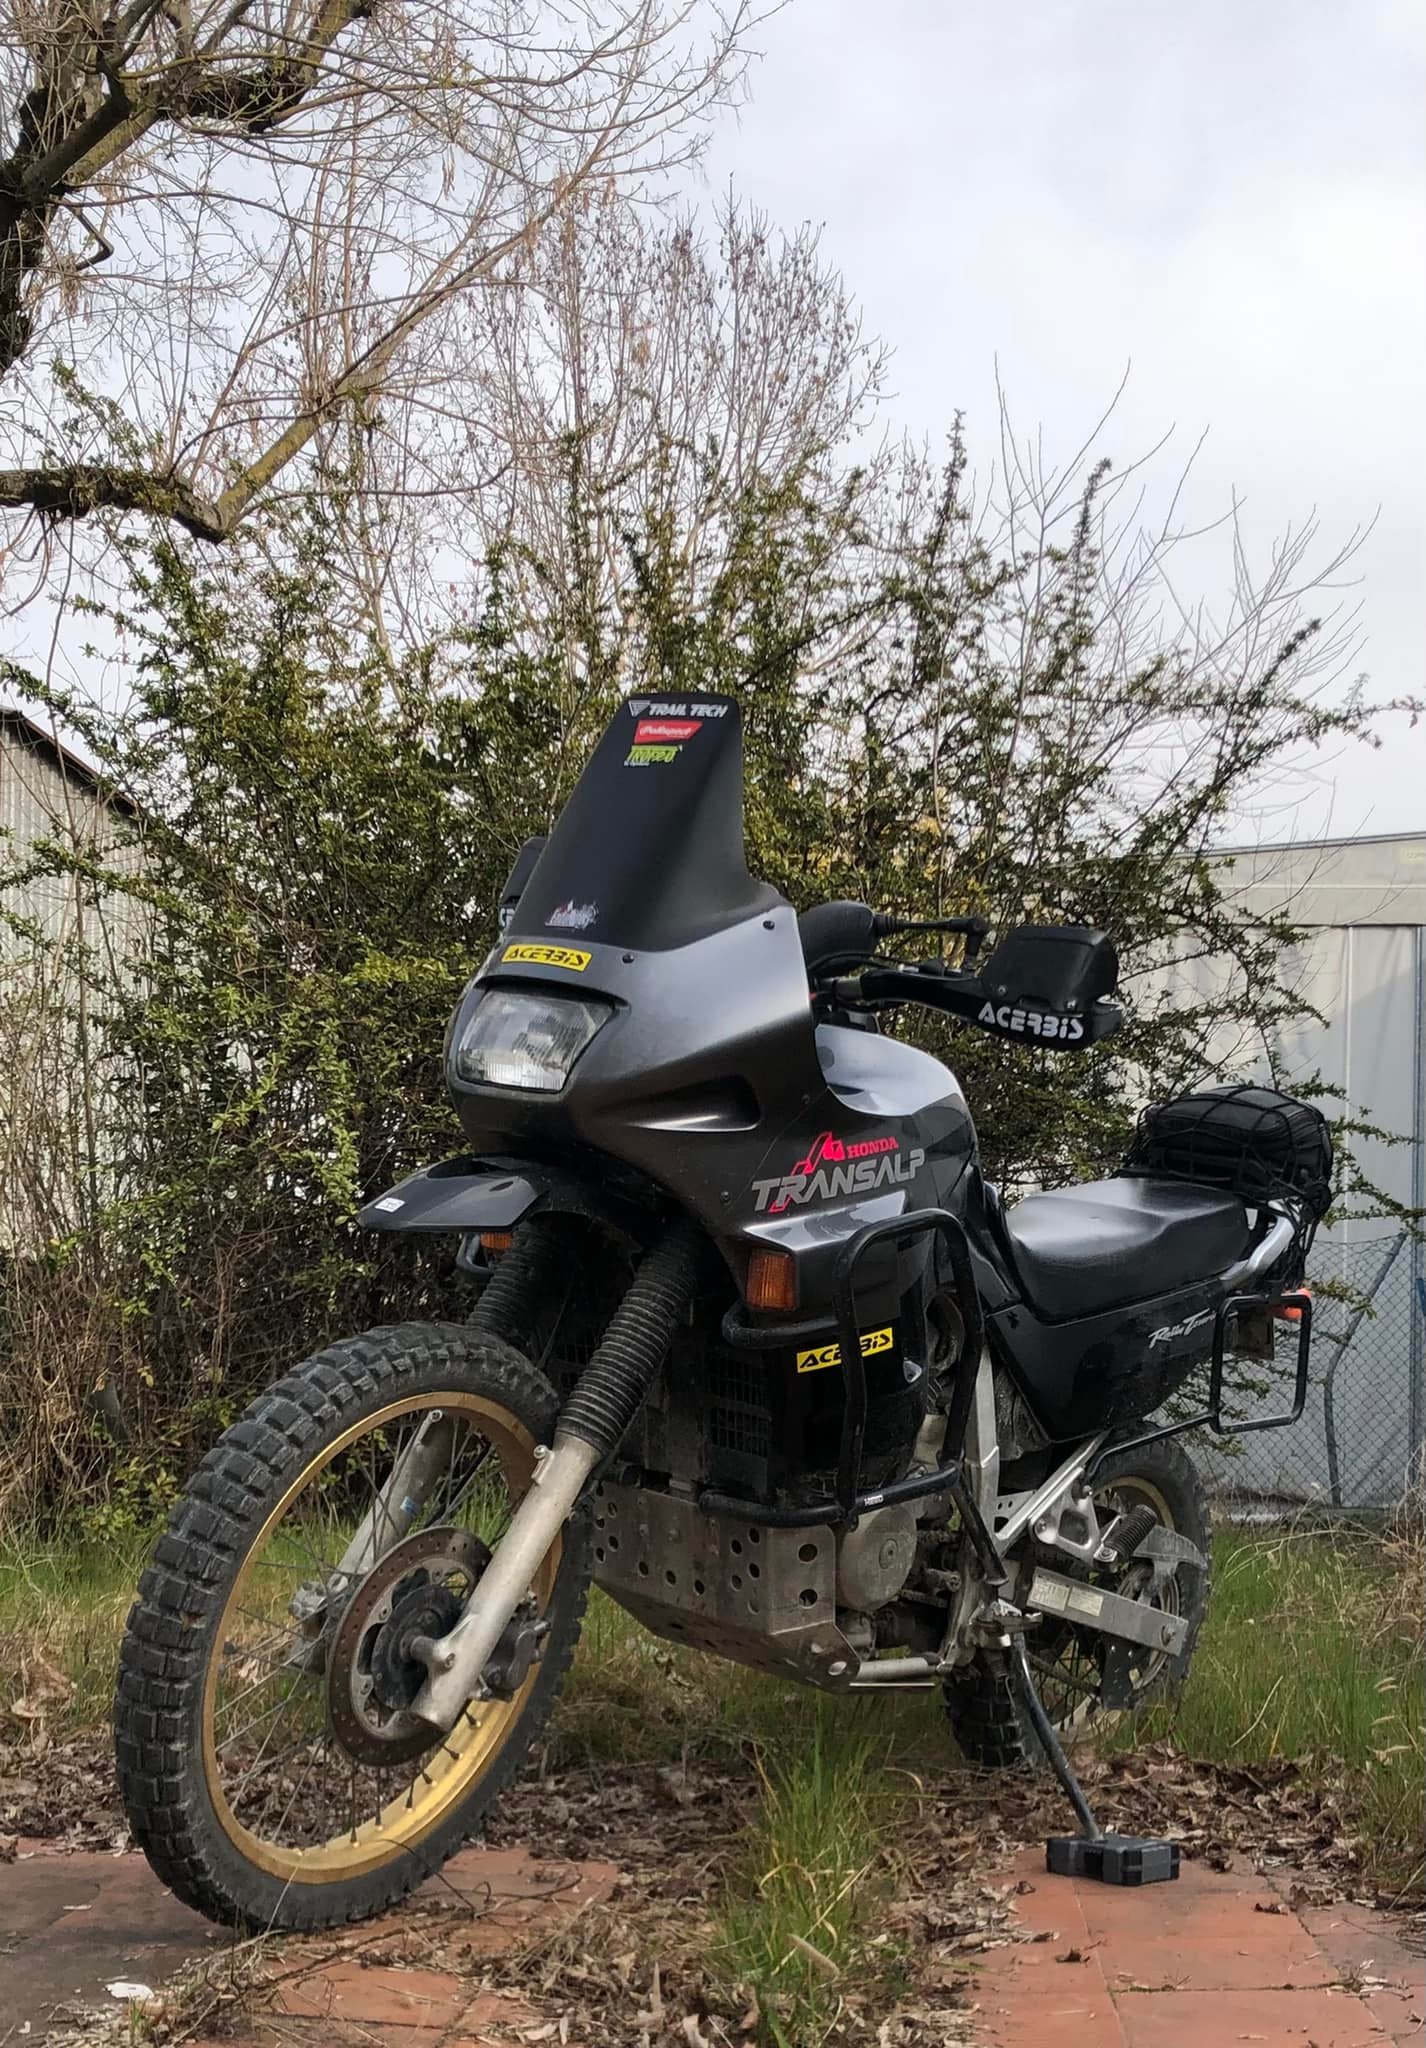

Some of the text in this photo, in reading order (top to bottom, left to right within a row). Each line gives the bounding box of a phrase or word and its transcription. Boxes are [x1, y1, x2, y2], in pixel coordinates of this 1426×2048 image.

[649, 703, 728, 718] TRAIL TECH
[847, 1136, 899, 1159] HONDA
[752, 1148, 925, 1211] TRANSALP
